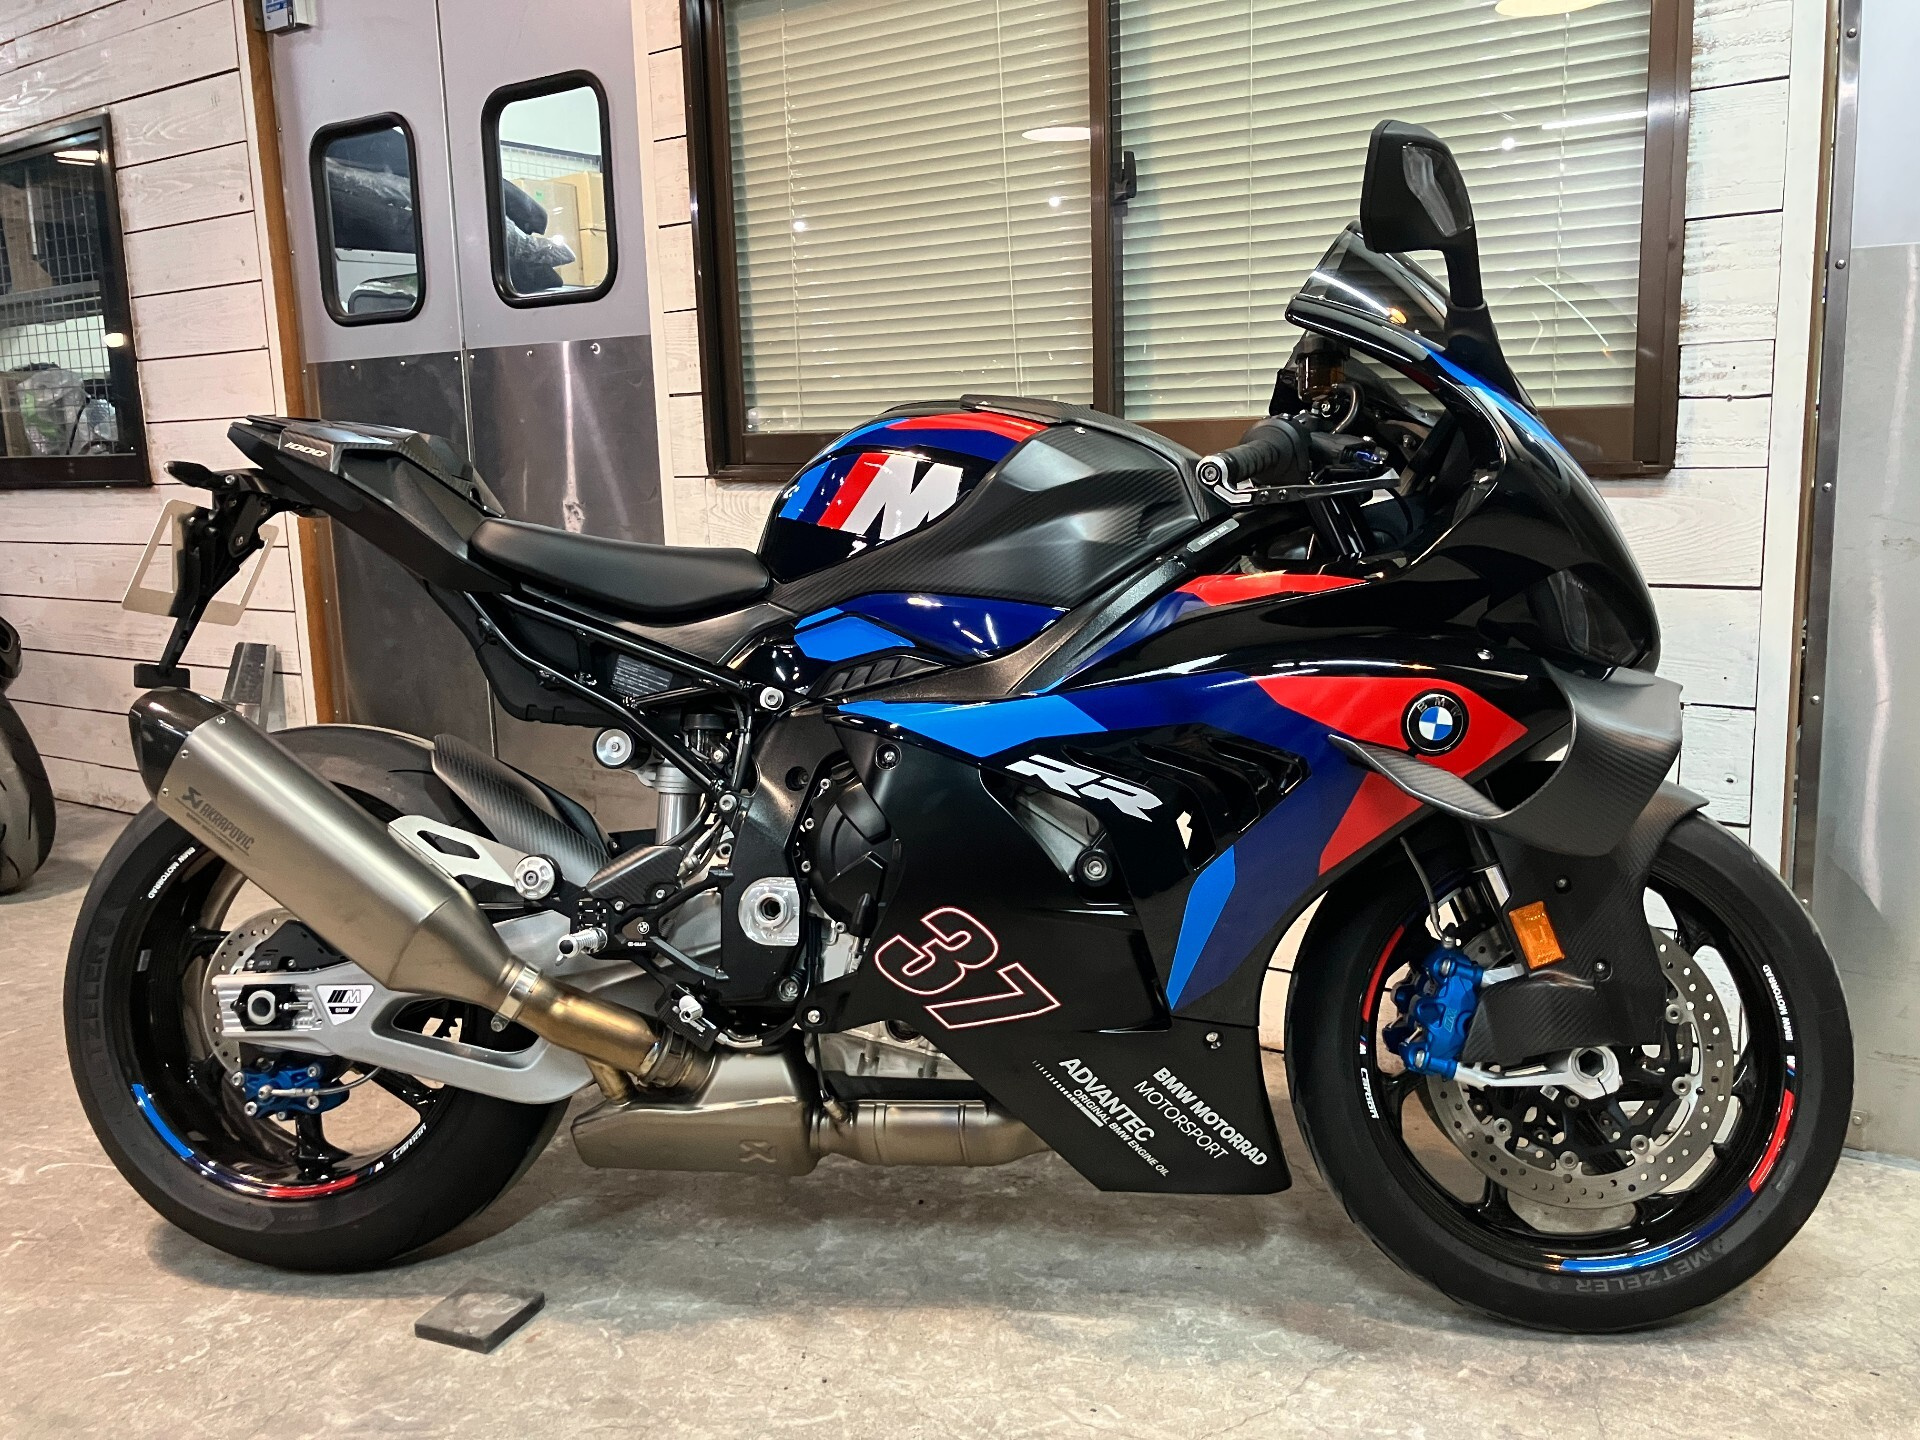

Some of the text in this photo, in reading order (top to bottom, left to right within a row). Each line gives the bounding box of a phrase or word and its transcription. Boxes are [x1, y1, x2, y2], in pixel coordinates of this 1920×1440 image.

[284, 441, 328, 458] 1000
[1416, 696, 1462, 718] BMW
[1004, 753, 1164, 823] RR
[147, 861, 180, 899] MOTORRAD
[874, 906, 1063, 1030] 37
[1762, 964, 1794, 1041] MOTORRAD BMW
[1058, 1058, 1155, 1142] ADVANTEC
[1073, 1088, 1170, 1177] ORIGINAL BMW ENGINE OIL
[1133, 1080, 1229, 1159] MOTORSPORT
[1152, 1066, 1268, 1165] BMW MOTORRAD
[1574, 1248, 1714, 1293] METZELER
